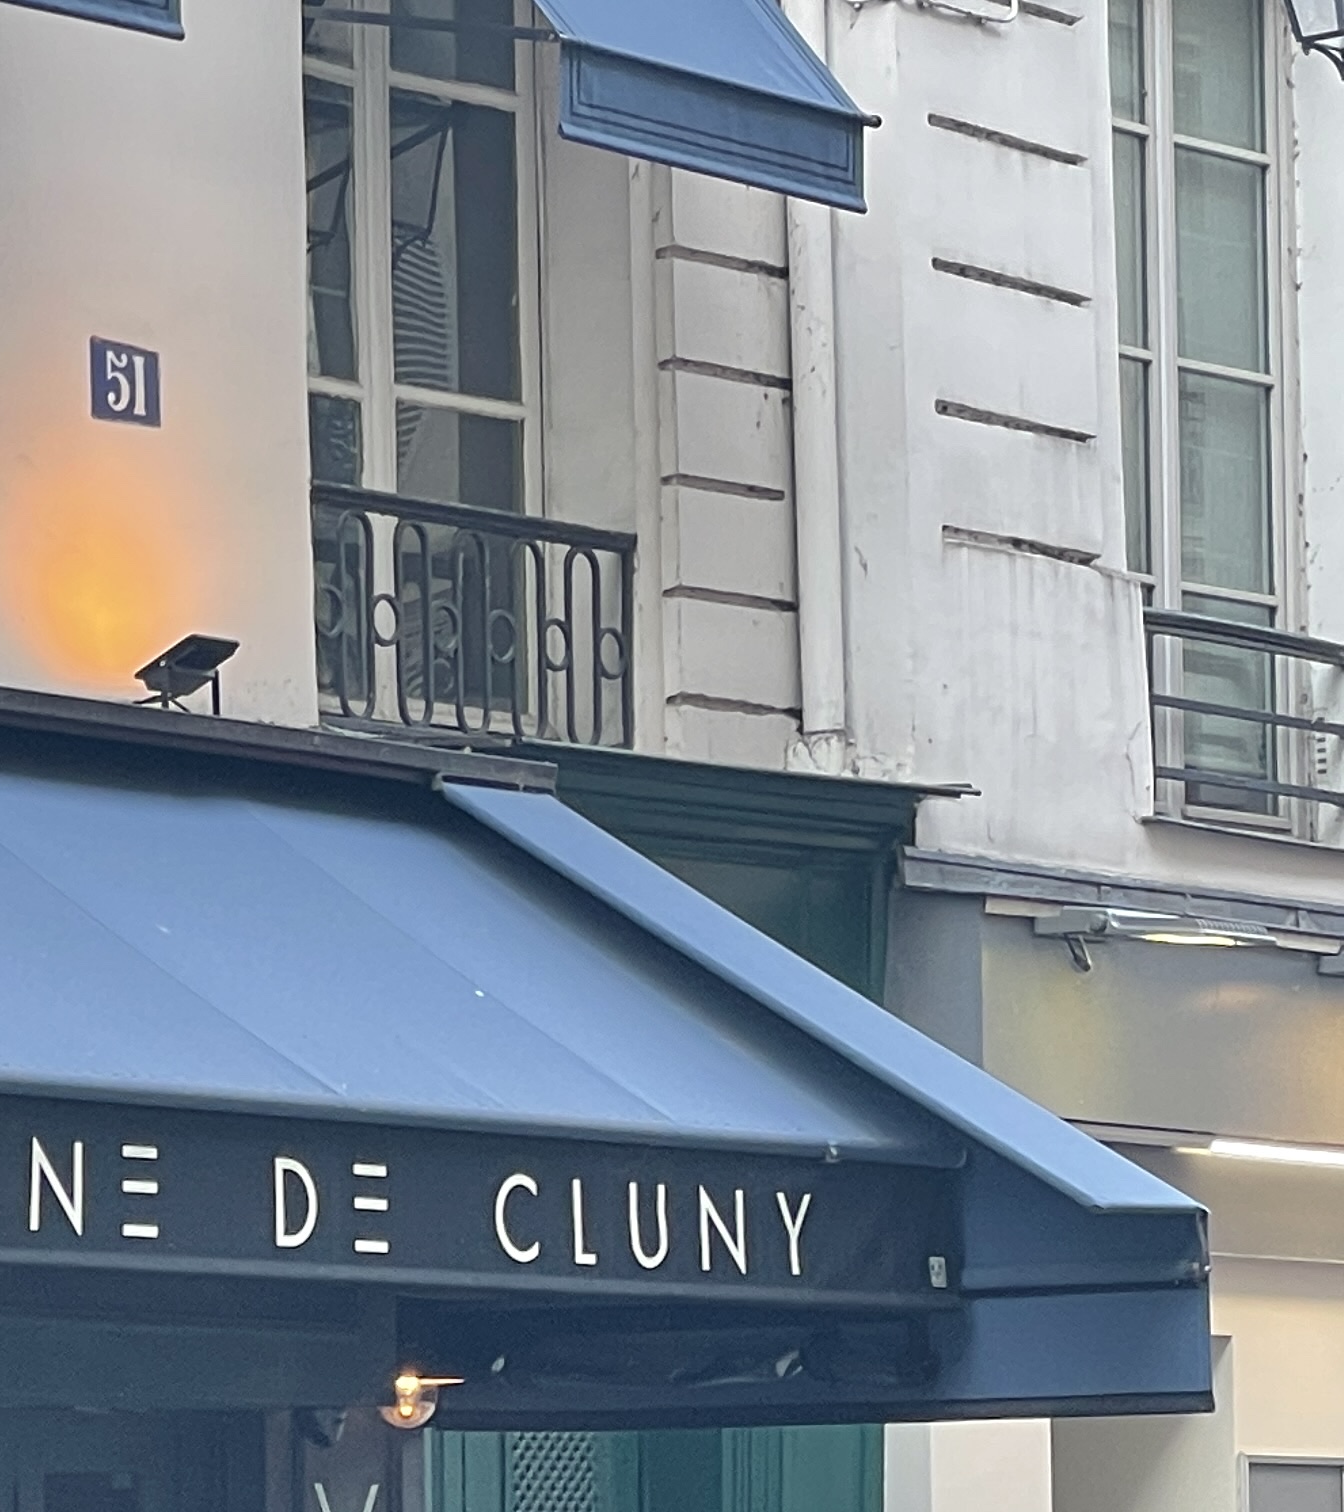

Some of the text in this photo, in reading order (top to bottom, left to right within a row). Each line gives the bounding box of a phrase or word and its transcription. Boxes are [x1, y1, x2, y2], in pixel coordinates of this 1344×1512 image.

[105, 350, 147, 416] 51
[273, 1156, 389, 1254] DE
[495, 1173, 812, 1277] CLUNY
